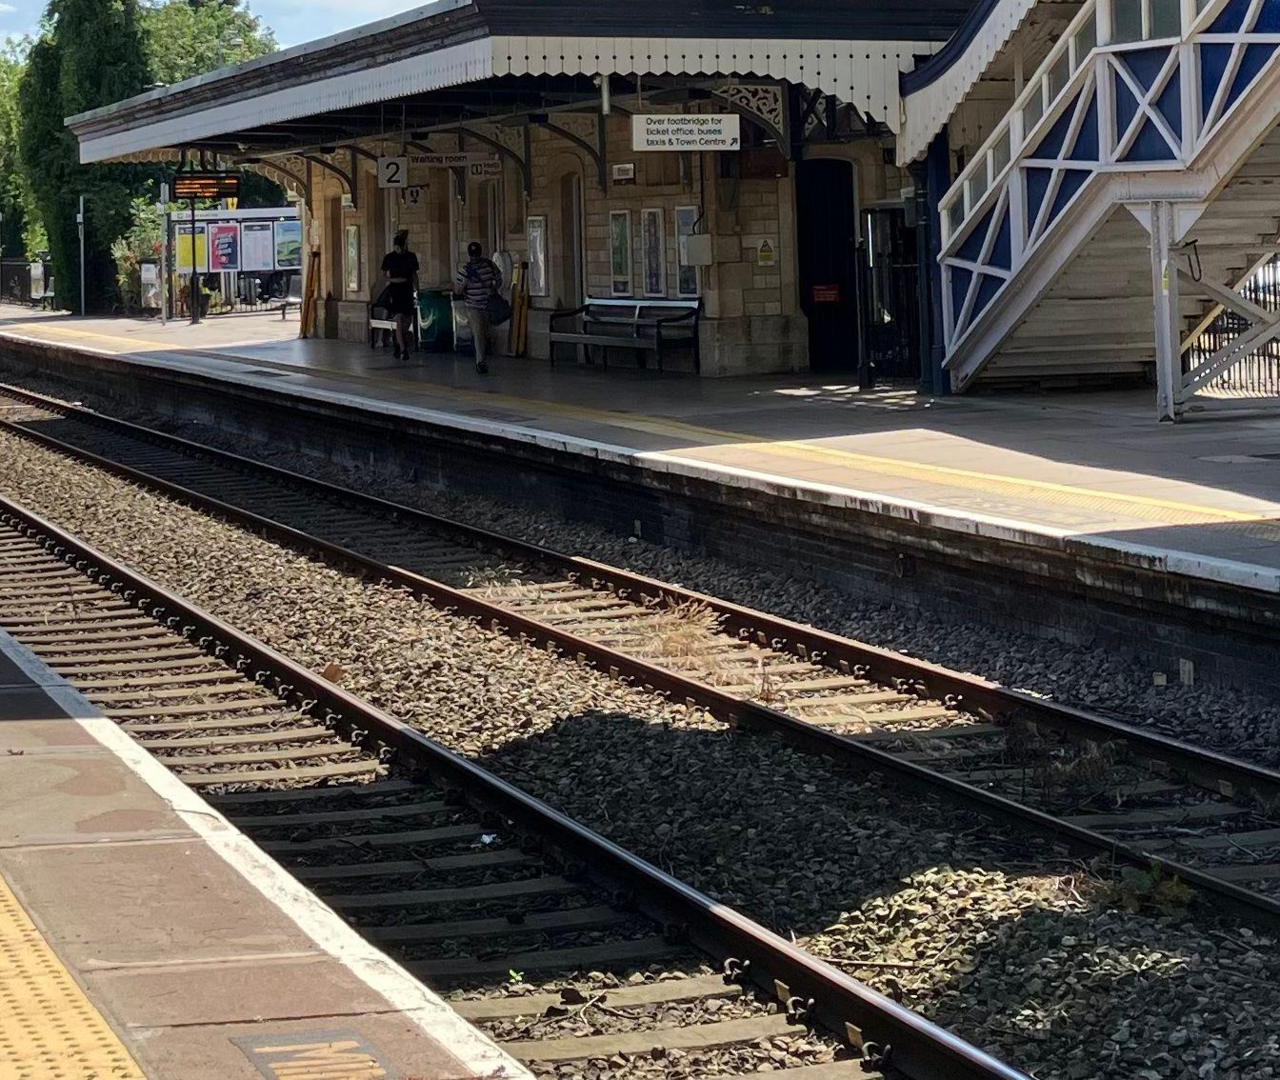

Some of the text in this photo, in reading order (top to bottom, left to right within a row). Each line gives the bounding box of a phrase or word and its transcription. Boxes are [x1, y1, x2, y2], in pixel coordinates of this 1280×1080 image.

[646, 117, 722, 126] Over footbridge for
[646, 127, 670, 136] ticket
[697, 127, 722, 135] buses
[646, 137, 726, 146] taxis & Town Centre
[385, 162, 400, 183] 2
